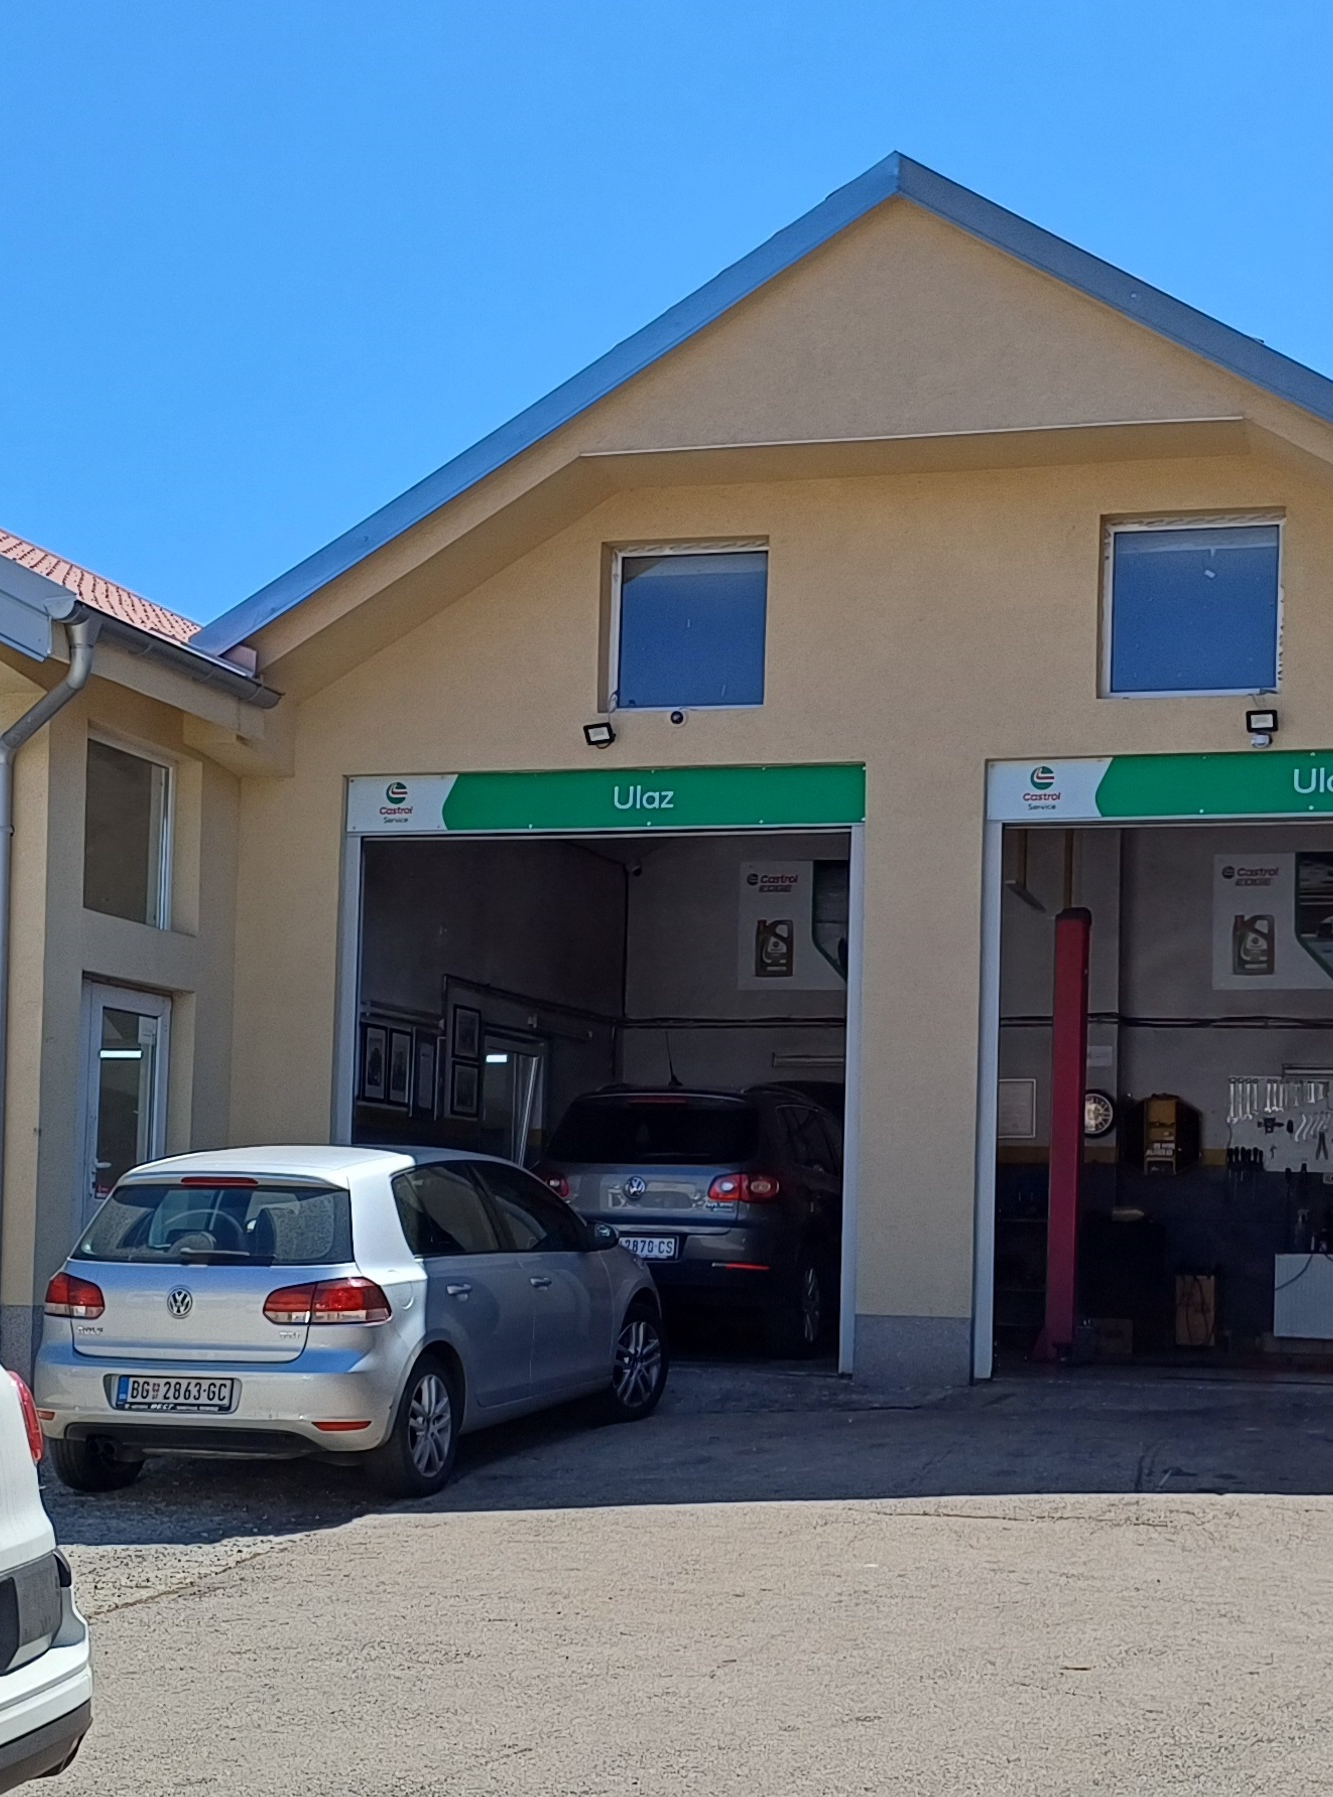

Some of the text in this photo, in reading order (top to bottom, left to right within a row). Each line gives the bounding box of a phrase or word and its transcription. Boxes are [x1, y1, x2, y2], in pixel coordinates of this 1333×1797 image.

[613, 785, 675, 810] Ulaz
[1022, 791, 1062, 802] Castrol
[379, 805, 414, 816] Castrol
[1027, 803, 1057, 811] Service
[383, 816, 409, 825] Service
[1237, 867, 1280, 878] Castrol
[760, 874, 798, 884] Castrol
[130, 1379, 150, 1400] BG
